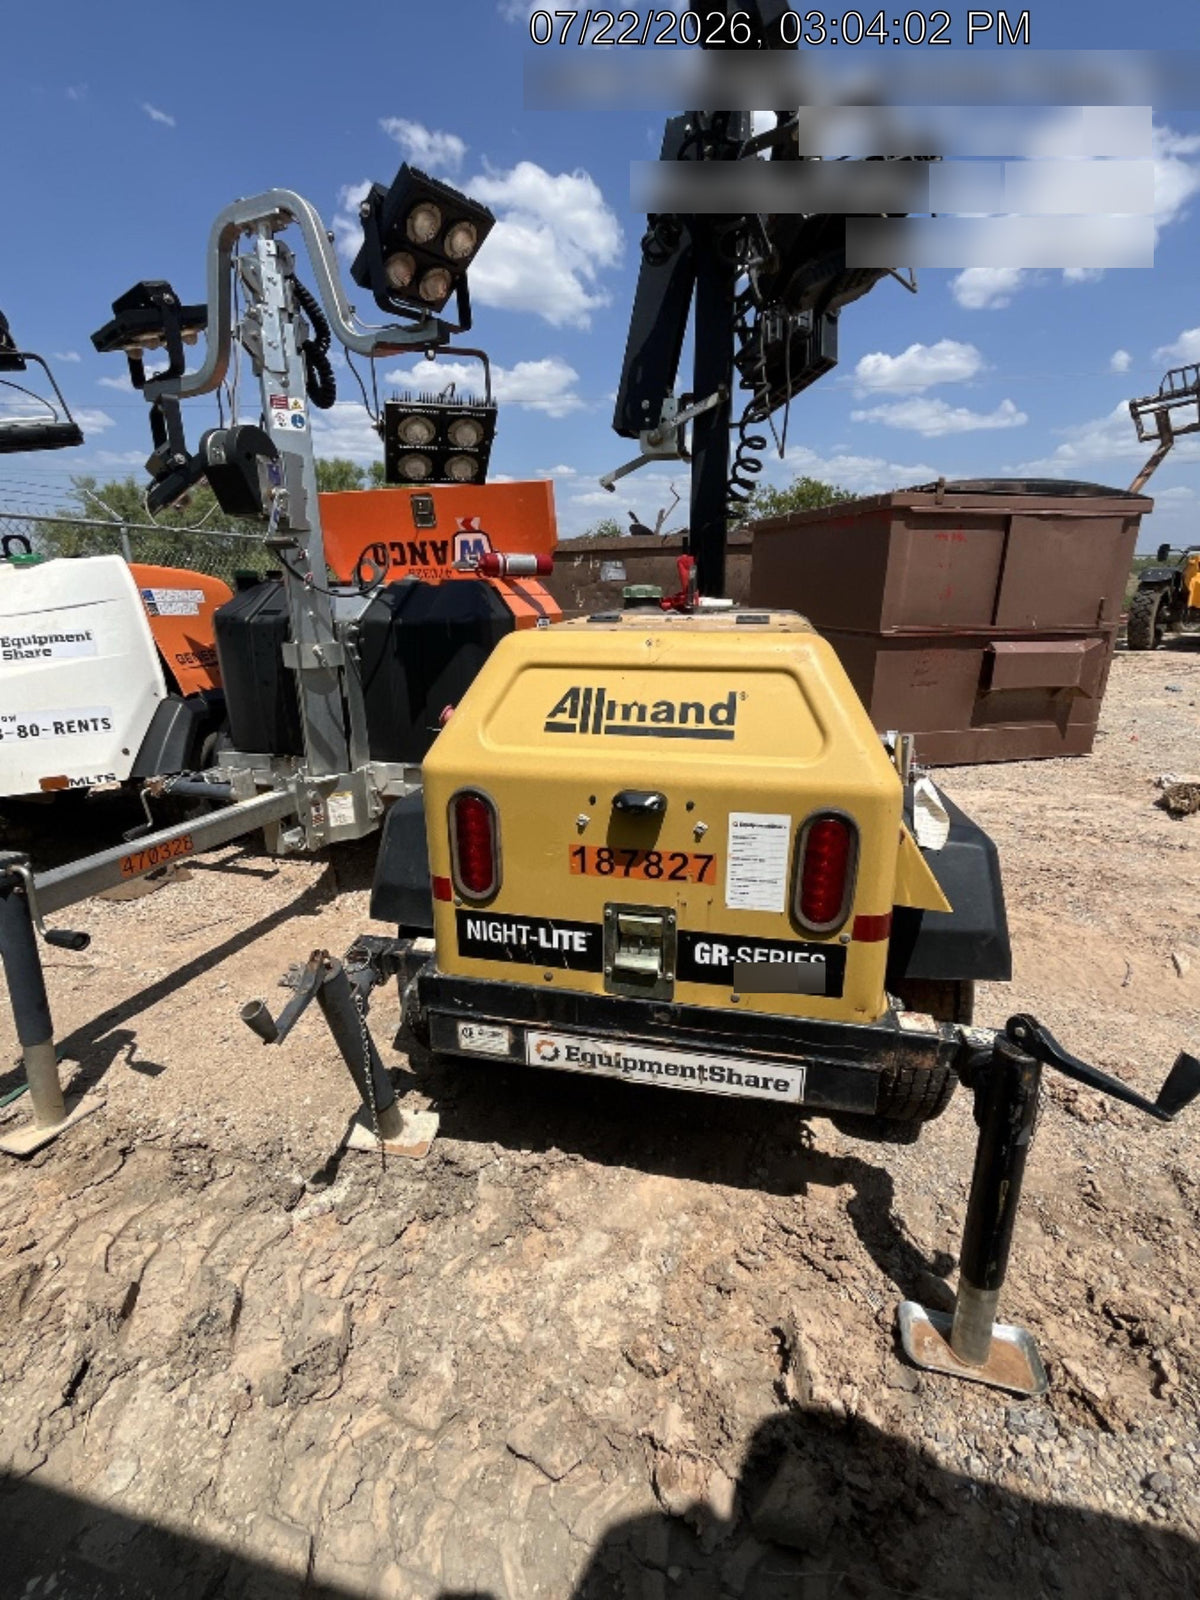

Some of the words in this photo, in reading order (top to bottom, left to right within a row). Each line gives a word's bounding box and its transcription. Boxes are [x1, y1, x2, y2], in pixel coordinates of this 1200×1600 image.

[0, 629, 93, 649] Equipment
[2, 648, 52, 660] Share
[546, 687, 737, 735] Allmand
[122, 834, 193, 873] 470328
[572, 846, 714, 882] 187827
[466, 918, 588, 952] NIGHT-LITE
[564, 1044, 791, 1093] EquipmentShare
